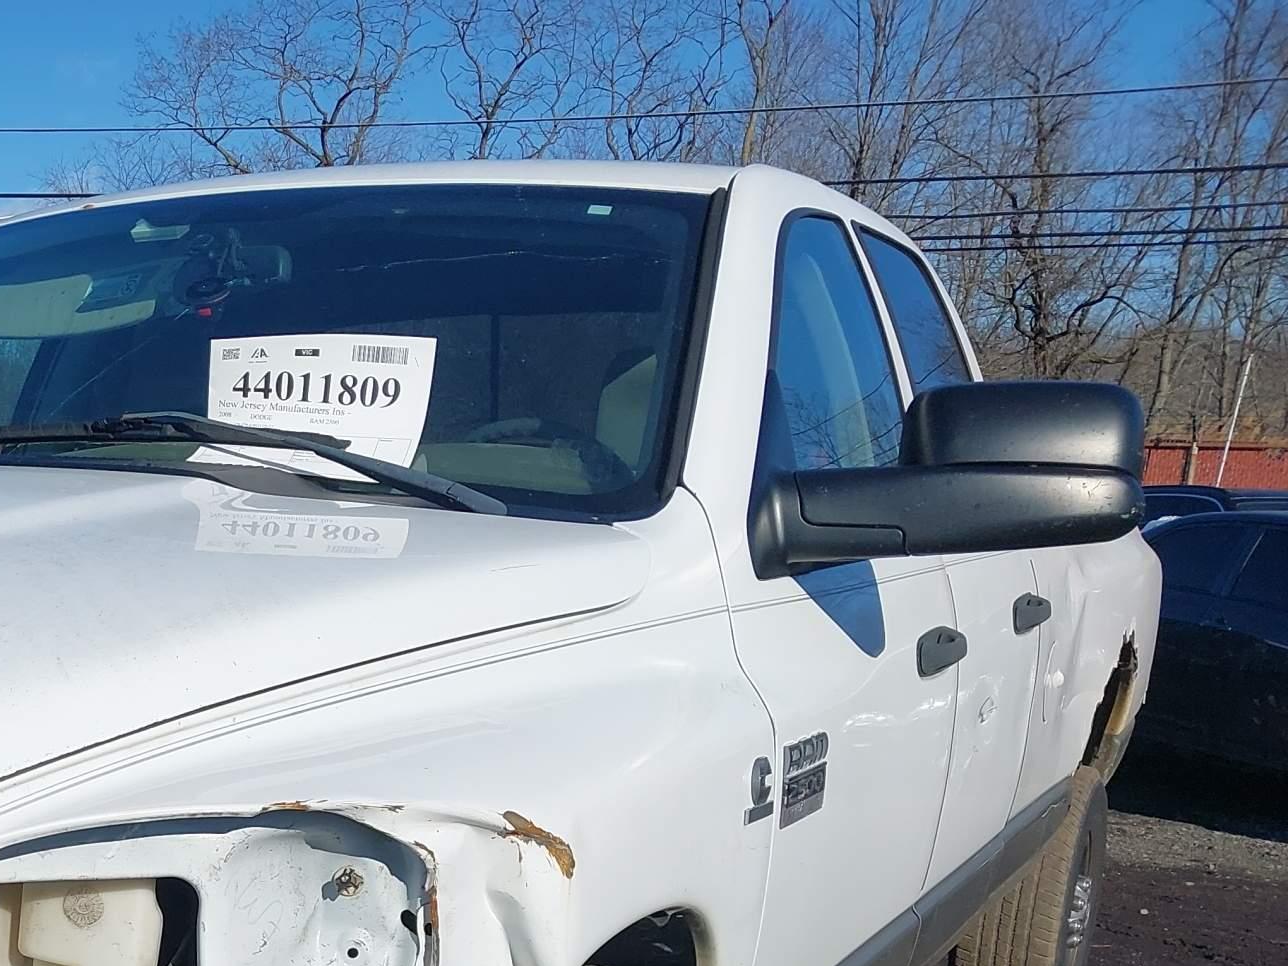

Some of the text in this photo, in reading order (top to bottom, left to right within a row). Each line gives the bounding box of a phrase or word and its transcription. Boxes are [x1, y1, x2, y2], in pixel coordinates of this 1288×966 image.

[232, 371, 401, 408] 44011809
[218, 400, 239, 409] New
[240, 401, 267, 412] Jersey
[269, 402, 330, 416] Manufacturers
[332, 407, 346, 416] Ins
